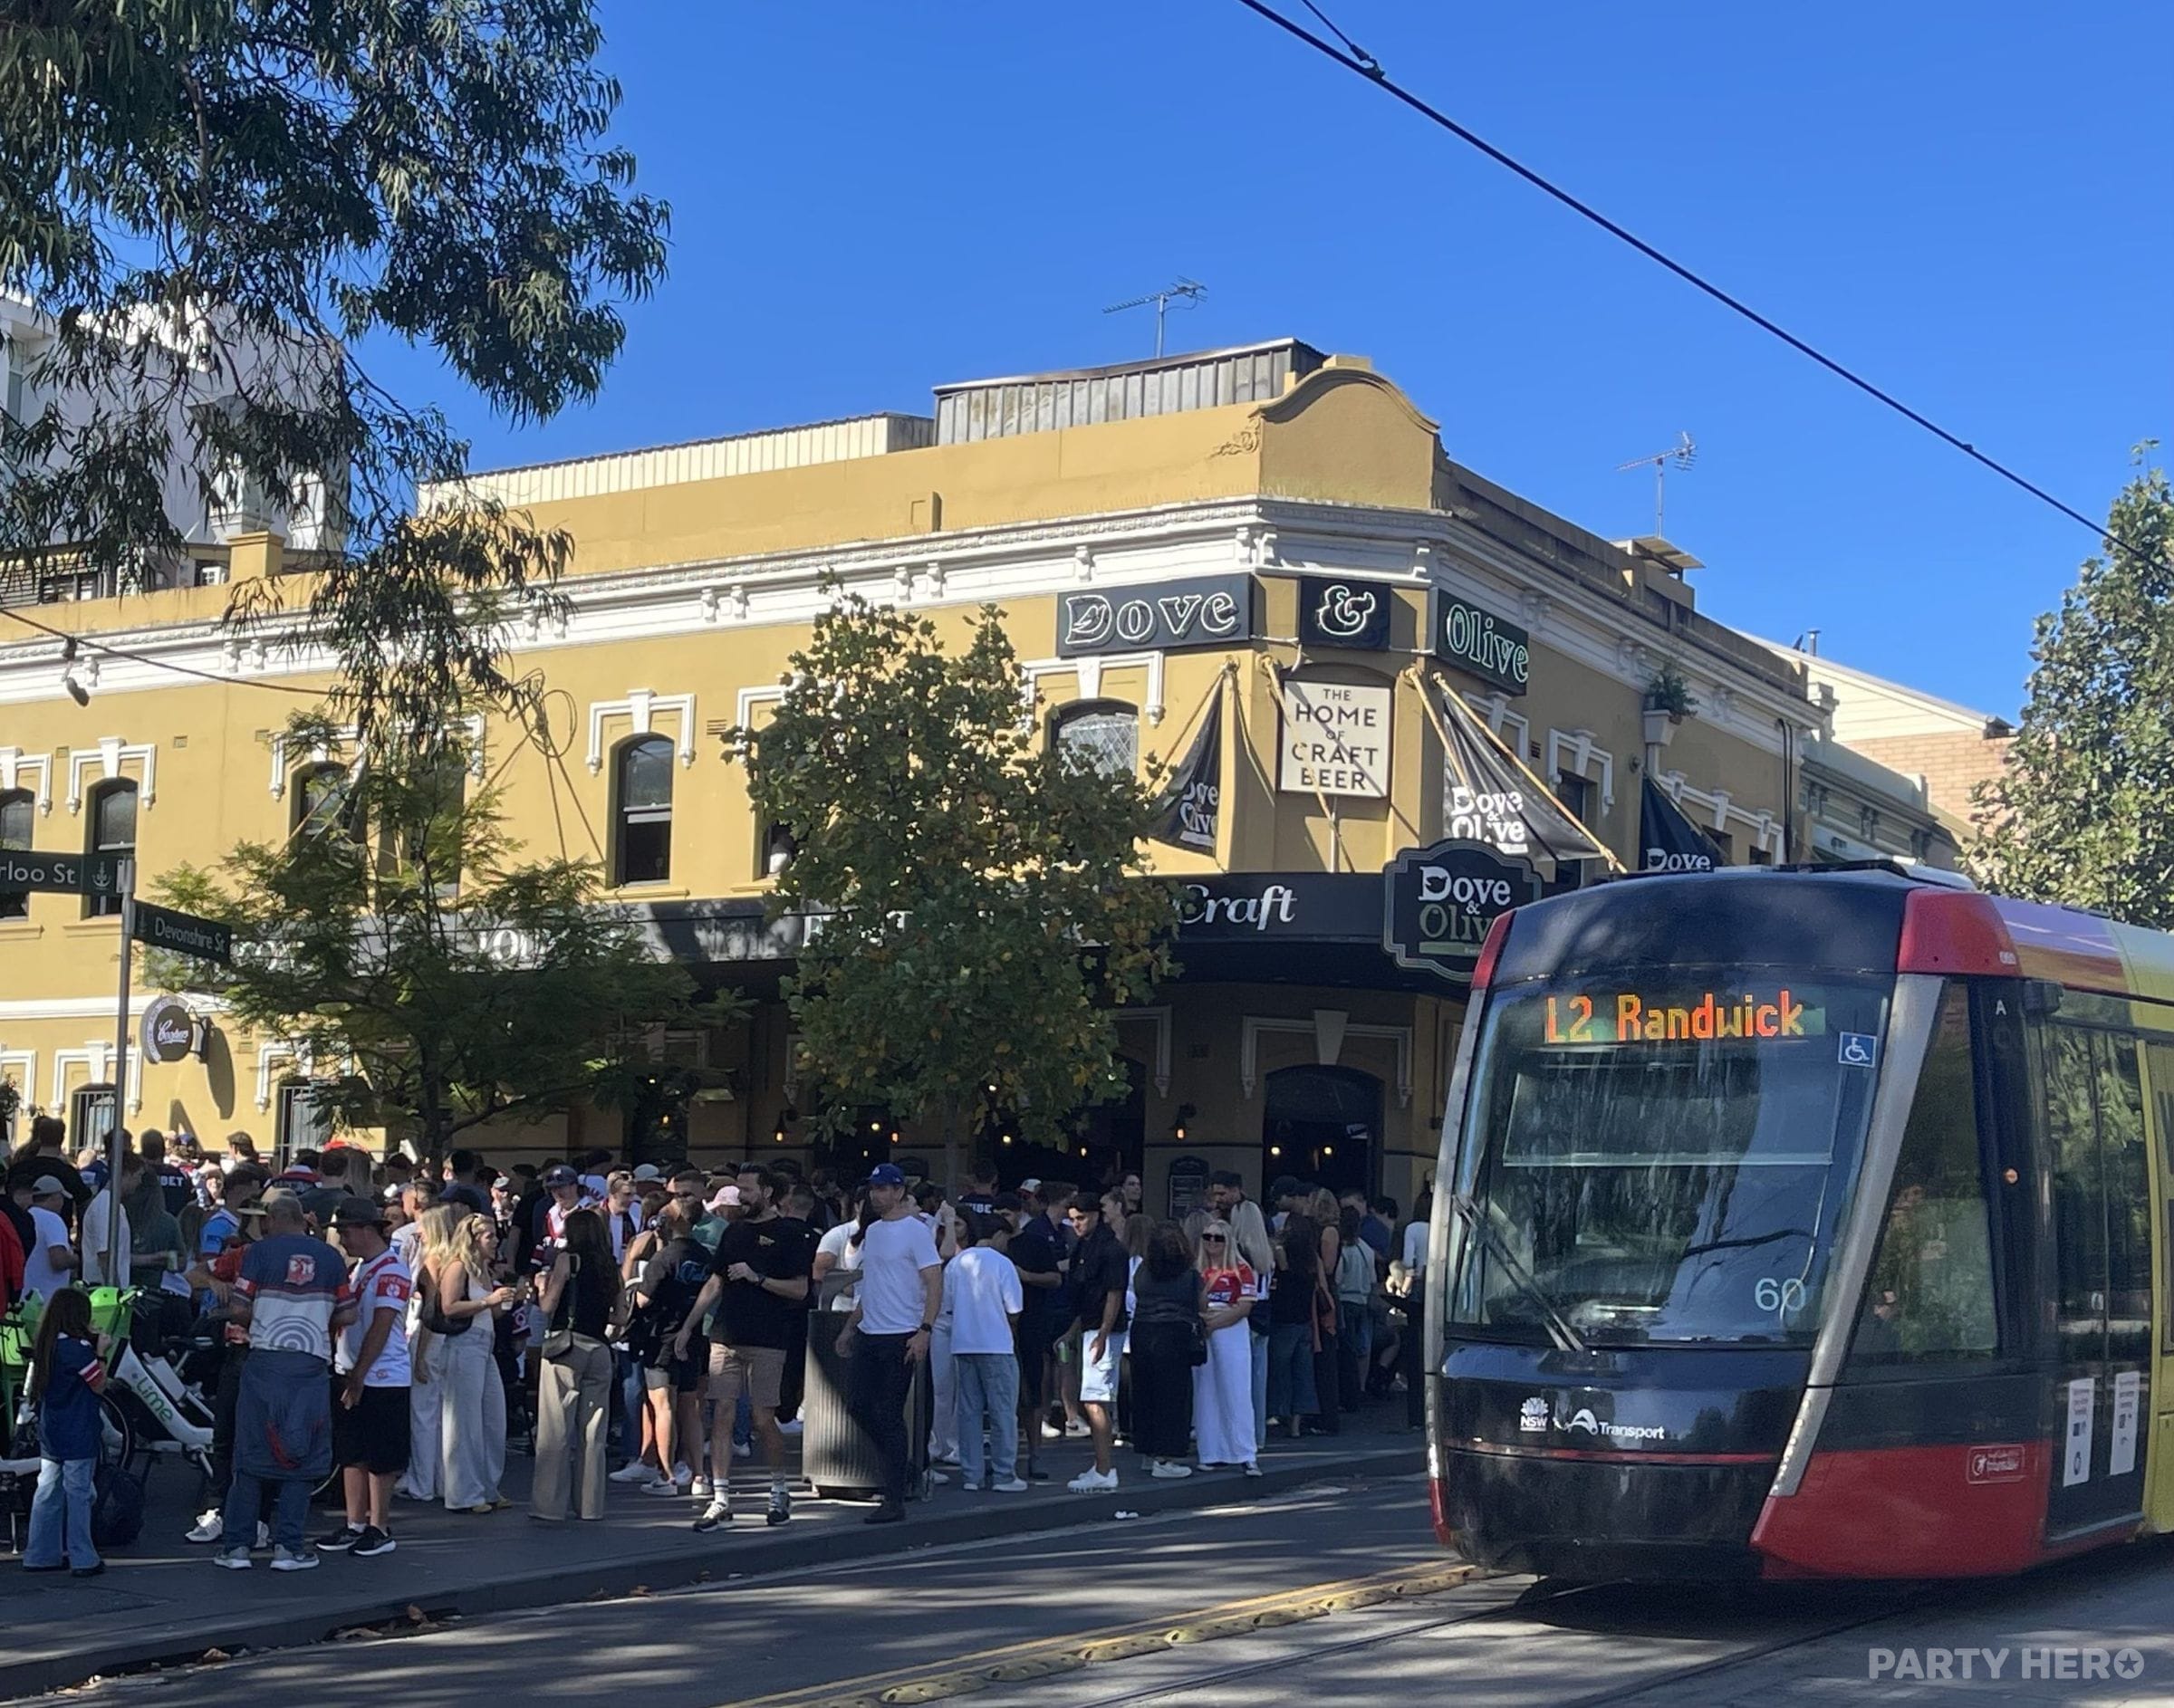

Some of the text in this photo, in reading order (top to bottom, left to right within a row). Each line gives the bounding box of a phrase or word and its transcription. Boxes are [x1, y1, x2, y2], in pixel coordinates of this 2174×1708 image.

[1064, 591, 1240, 648] Dove
[1316, 584, 1376, 637] &
[1446, 603, 1529, 684] Olive
[1323, 688, 1352, 701] THE
[1295, 703, 1377, 727] HOME
[1325, 730, 1345, 741] OF
[1292, 742, 1379, 766] CRAFT
[1301, 767, 1366, 790] BEER
[1451, 786, 1524, 814] Dove
[1646, 848, 1711, 871] Dove
[53, 862, 76, 885] St
[1419, 866, 1512, 906] Dove
[1465, 900, 1481, 916] &
[1419, 903, 1495, 942] Oliv
[155, 916, 226, 954] Devonshire St
[1546, 989, 1805, 1042] L2 Randwick
[1996, 999, 2007, 1015] A
[1755, 1276, 1806, 1312] 60
[137, 1376, 173, 1421] Lime
[1520, 1415, 1547, 1428] NSW
[1598, 1422, 1665, 1440] Transport
